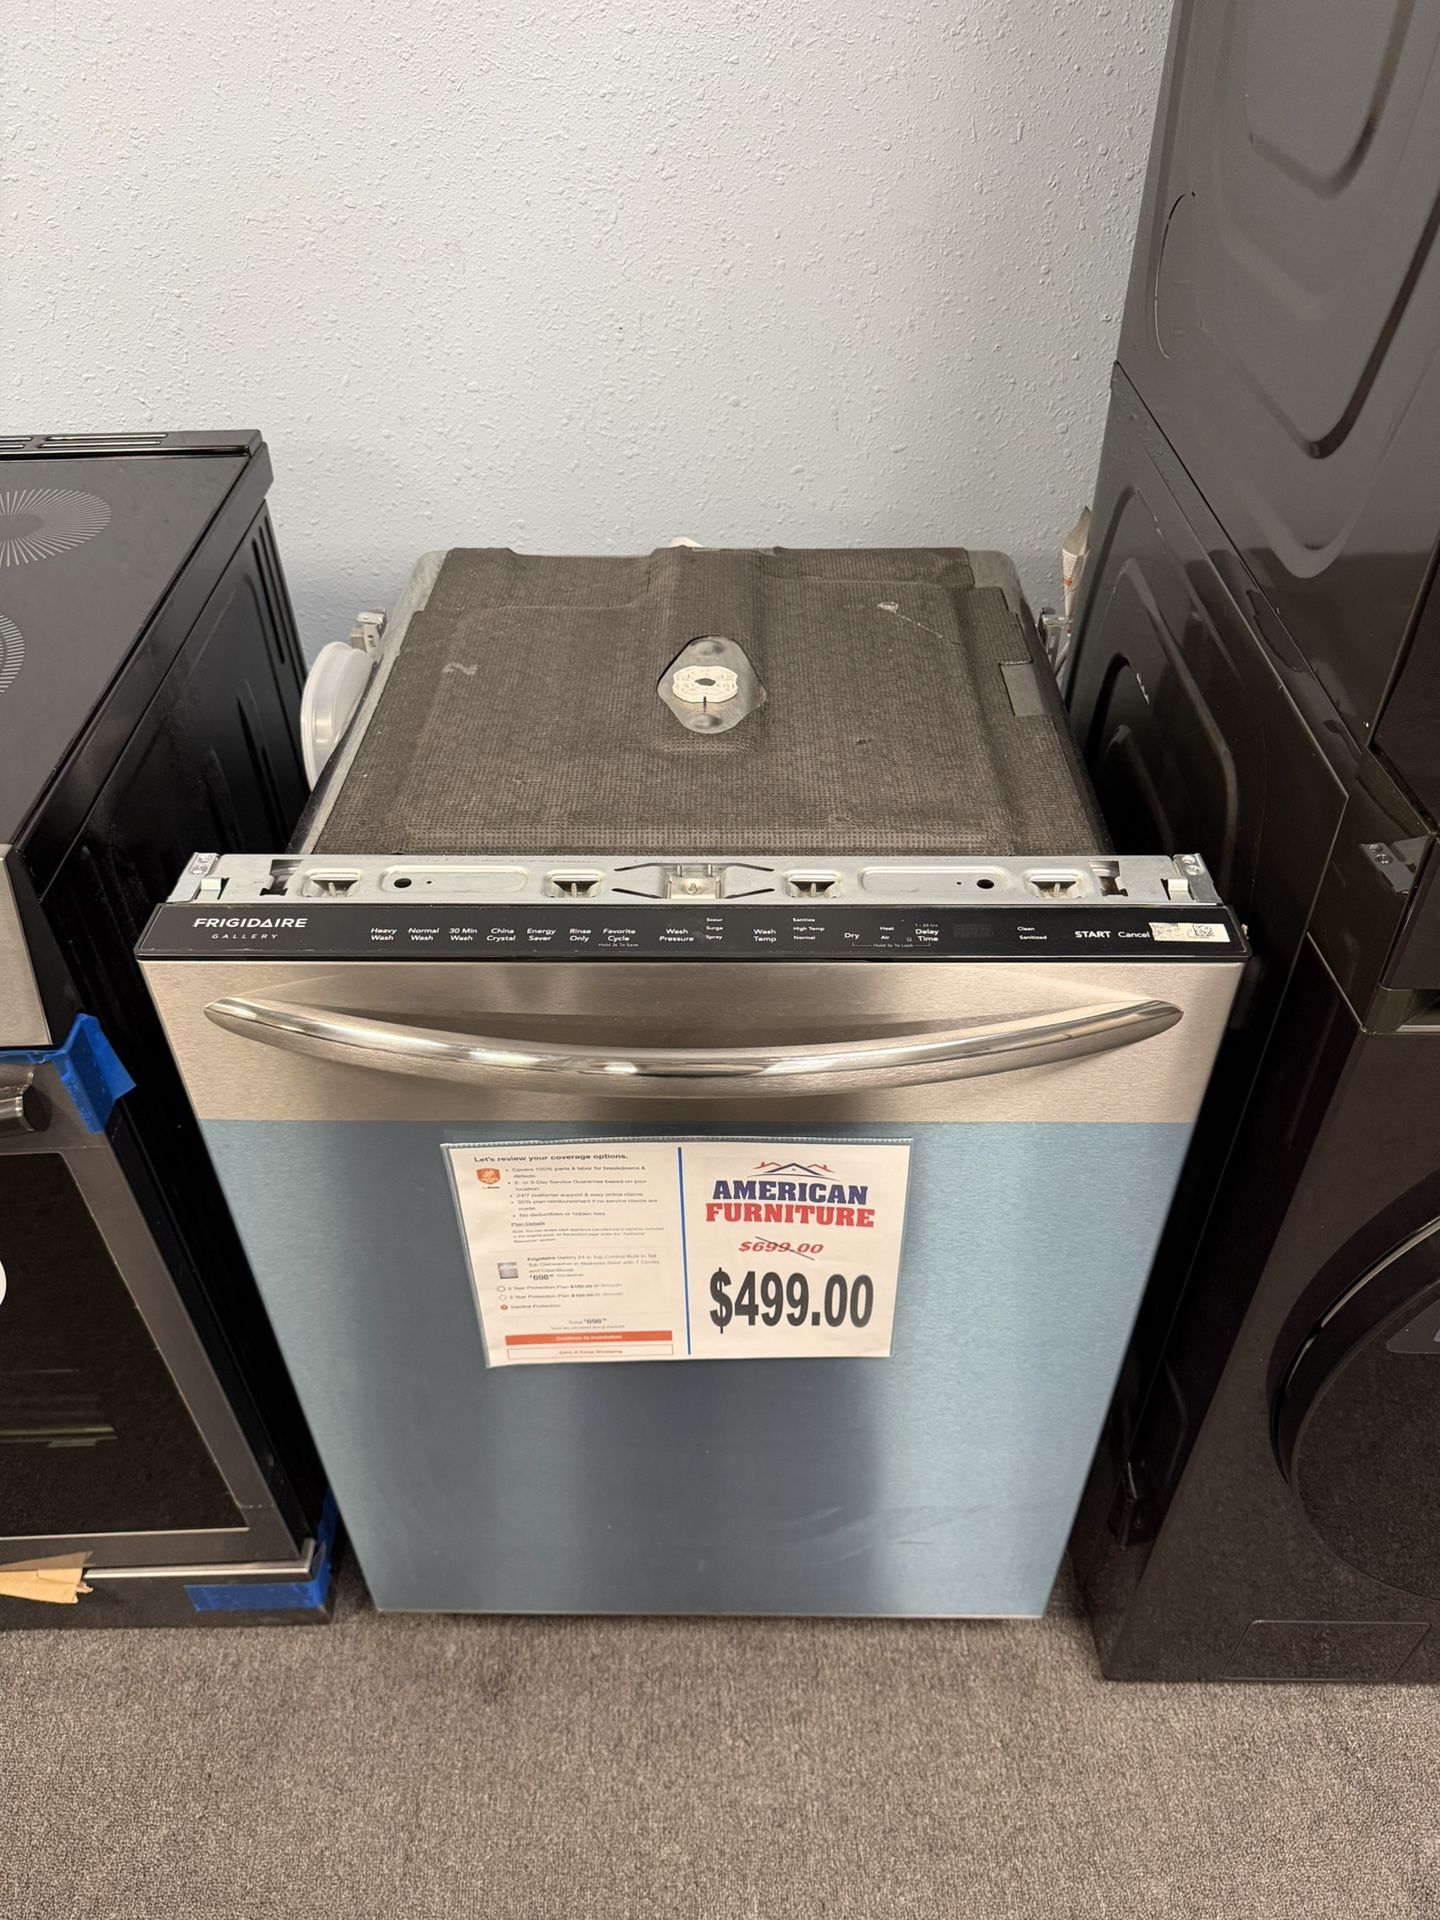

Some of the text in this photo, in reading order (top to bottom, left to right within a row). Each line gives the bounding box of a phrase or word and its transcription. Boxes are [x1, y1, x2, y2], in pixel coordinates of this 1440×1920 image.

[193, 918, 308, 928] FRIGIDAIRE
[370, 927, 398, 935] Heavy
[915, 928, 939, 936] Delay
[486, 935, 516, 943] Crystal
[569, 935, 590, 943] Only
[844, 932, 860, 940] Dry
[713, 1180, 868, 1205] AMERICAN
[705, 1203, 875, 1228] FURNITURE
[738, 1241, 824, 1254] $699.00
[710, 1267, 874, 1334] $499.00
